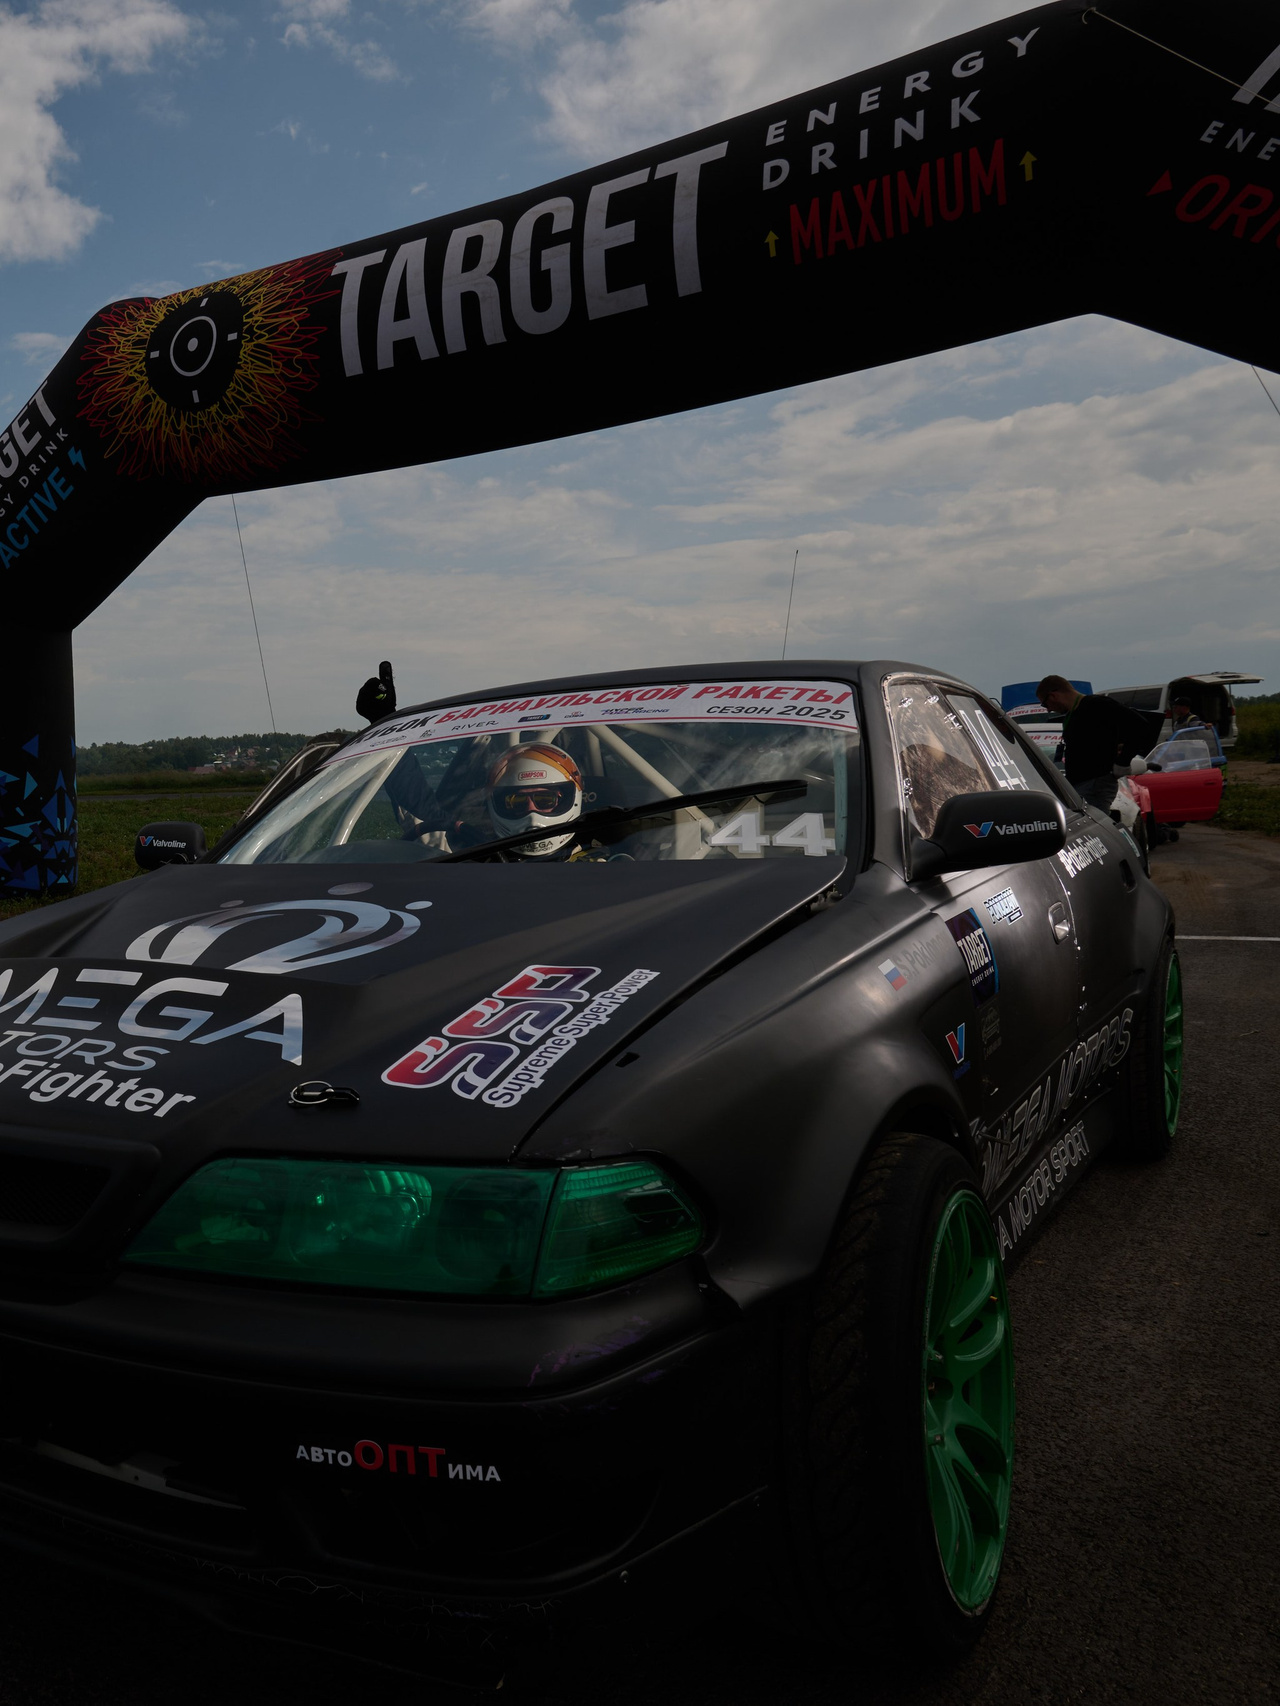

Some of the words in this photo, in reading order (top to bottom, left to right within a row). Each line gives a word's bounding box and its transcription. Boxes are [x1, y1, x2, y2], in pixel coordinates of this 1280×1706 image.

[765, 27, 1041, 147] ENERGY
[762, 89, 982, 191] DRINK
[789, 137, 1008, 266] MAXIMUM
[331, 140, 729, 378] TARGET
[18, 427, 69, 490] DRINK
[435, 684, 690, 724] БАРНАУЛЬСКОЙ
[692, 685, 853, 705] РАКЕТЫ
[706, 706, 774, 715] СЕЗОН
[777, 705, 849, 720] 2025
[152, 839, 187, 849] Valvoline
[708, 811, 836, 857] 44
[995, 820, 1058, 836] Valvoline
[956, 928, 992, 975] TARGET
[1008, 1158, 1056, 1243] MOTOR
[1050, 1120, 1090, 1183] SPORT
